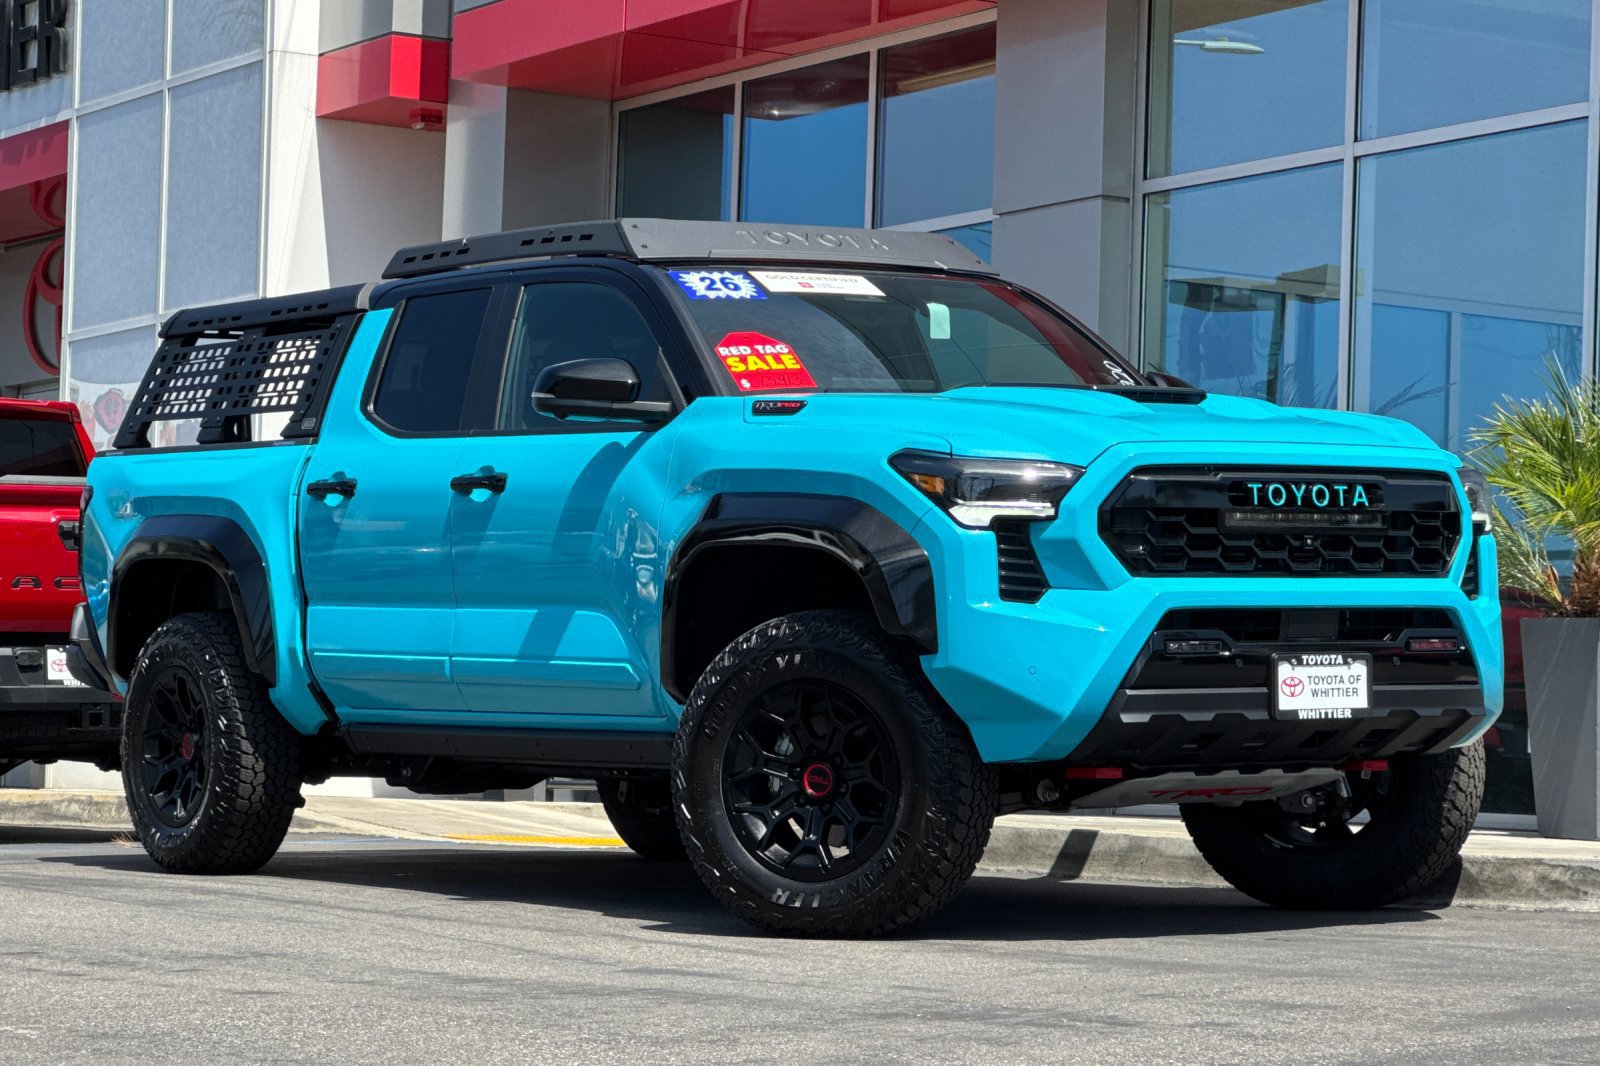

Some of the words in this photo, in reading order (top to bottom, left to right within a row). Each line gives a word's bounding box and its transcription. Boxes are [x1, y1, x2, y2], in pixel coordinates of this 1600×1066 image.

[736, 230, 889, 250] TOYOTA
[699, 276, 742, 292] 26
[717, 345, 752, 357] RED
[754, 344, 789, 354] TAG
[725, 354, 801, 372] SALE
[1248, 483, 1369, 507] TOYOTA
[1301, 654, 1344, 665] TOYOTA
[1307, 675, 1345, 686] TOYOTA
[1348, 674, 1362, 685] OF
[1311, 687, 1359, 698] WHITTIER
[1298, 708, 1352, 719] WHITTIER
